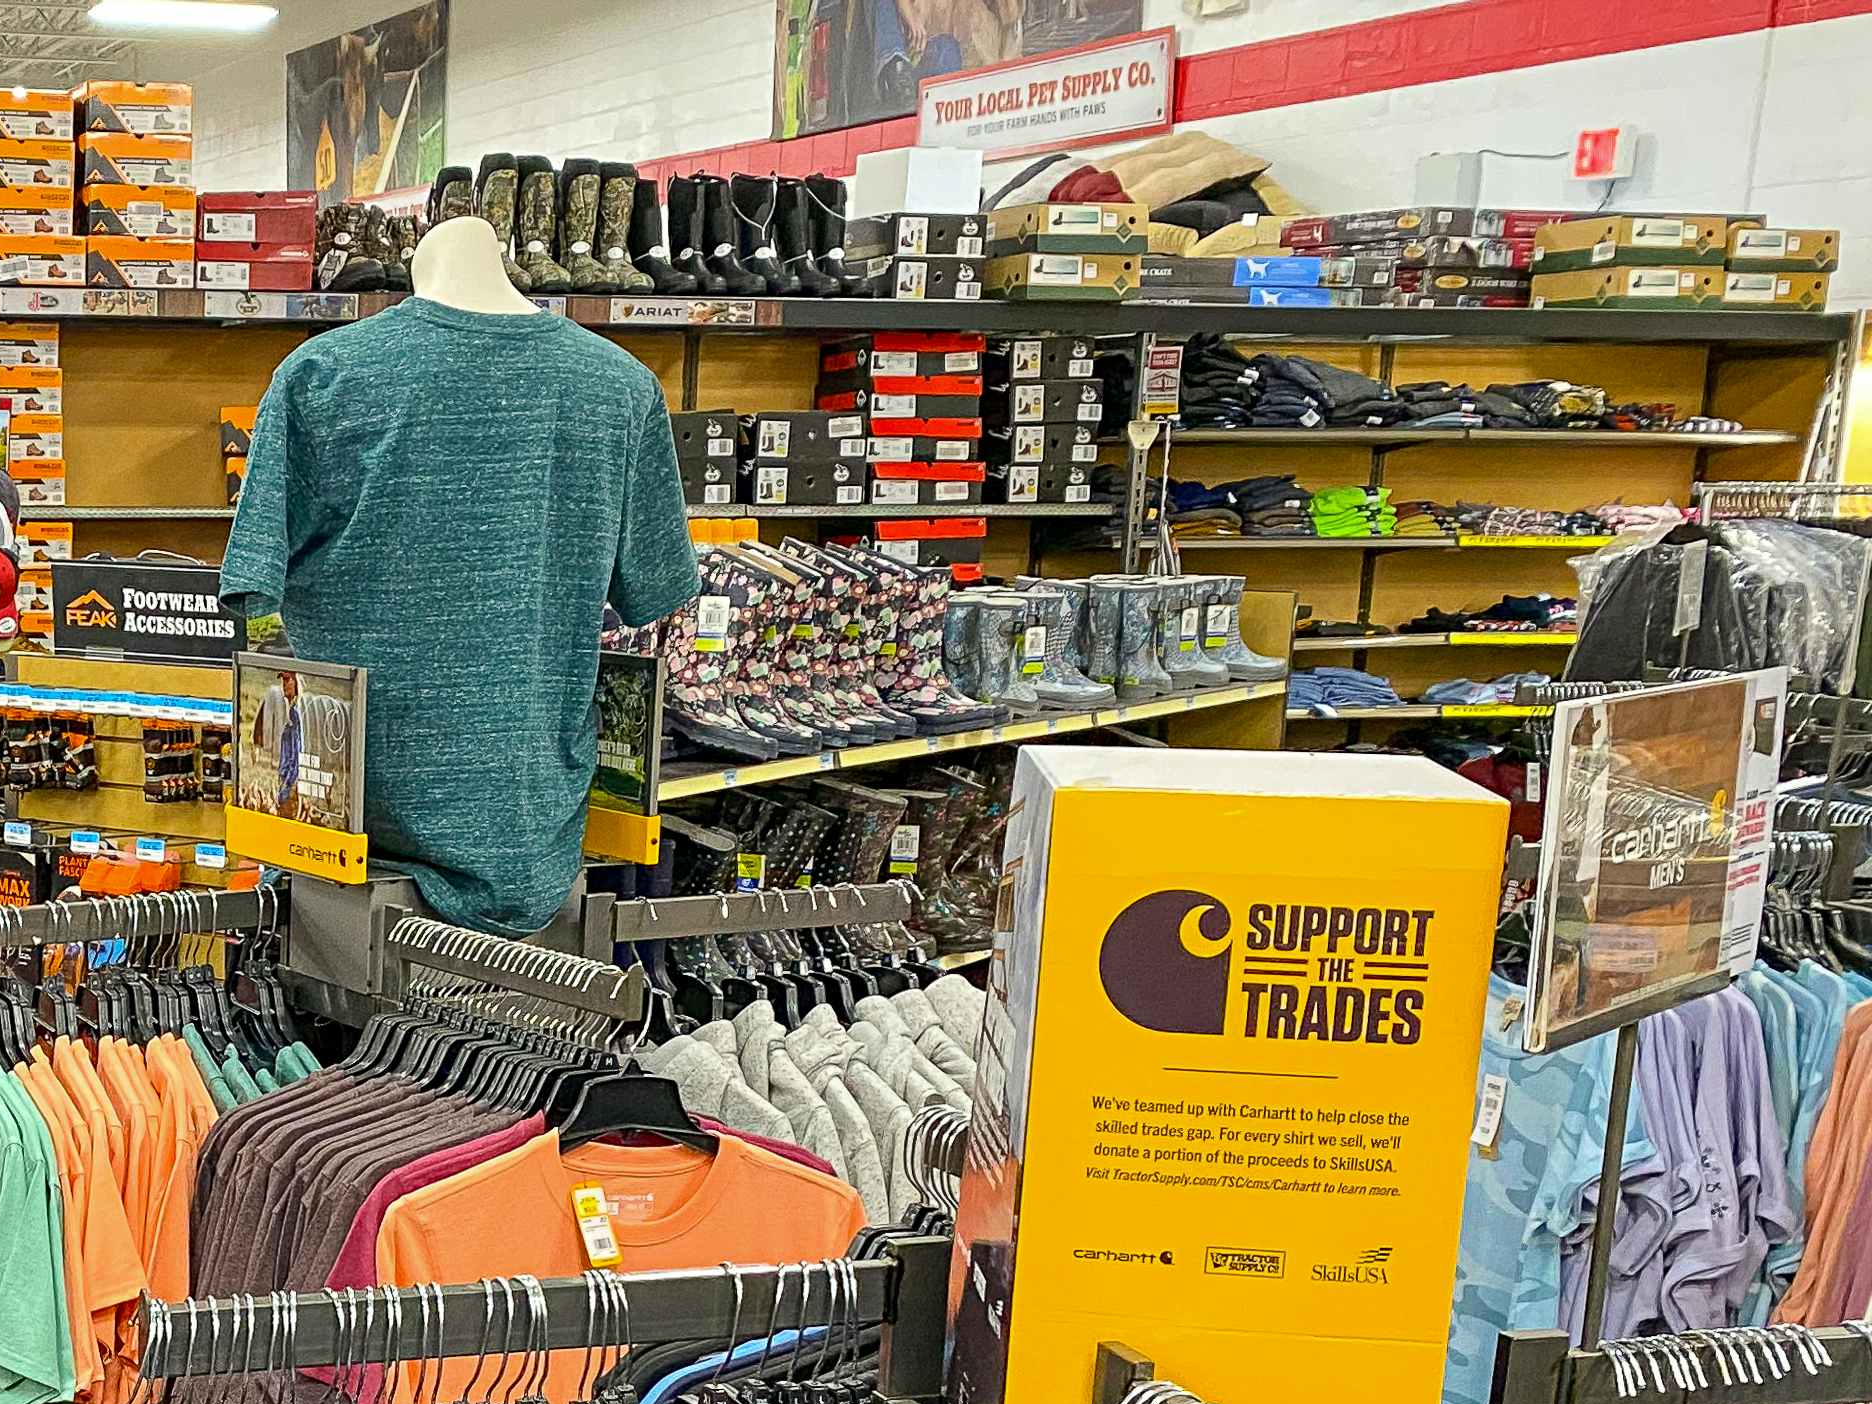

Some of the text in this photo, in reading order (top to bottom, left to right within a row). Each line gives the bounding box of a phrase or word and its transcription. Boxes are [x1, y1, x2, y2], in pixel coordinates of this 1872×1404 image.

[935, 61, 1156, 124] YOUR LOCAL PET SUPPLY CO.
[1007, 117, 1028, 130] FARM
[1030, 111, 1058, 126] HANDS
[1060, 106, 1081, 121] WITH
[1083, 102, 1106, 116] PAWS
[634, 307, 683, 316] ARIAT
[122, 588, 220, 613] FOOTWEAR
[123, 612, 235, 638] ACCESSORIES
[289, 843, 337, 865] carhartt
[1649, 860, 1686, 889] MEN'S
[1246, 904, 1435, 957] SUPPORT
[1317, 957, 1355, 983] THE
[1242, 982, 1425, 1045] TRADES
[1092, 1096, 1410, 1126] We've teamed up with Carhartt to help close the
[1095, 1120, 1401, 1150] skilled trades gap. For every shirt we sell, we'll
[1093, 1142, 1398, 1173] donate a portion of the proceeds to SkillsUSA.
[1085, 1167, 1111, 1180] Visit
[1323, 1182, 1336, 1194] to
[1337, 1183, 1367, 1196] learn
[1368, 1187, 1401, 1198] more.
[1073, 1249, 1157, 1265] carhartt
[1229, 1253, 1280, 1264] TRACTOR
[1229, 1262, 1268, 1273] SUPPLY
[1311, 1263, 1390, 1285] SkillsUSA
